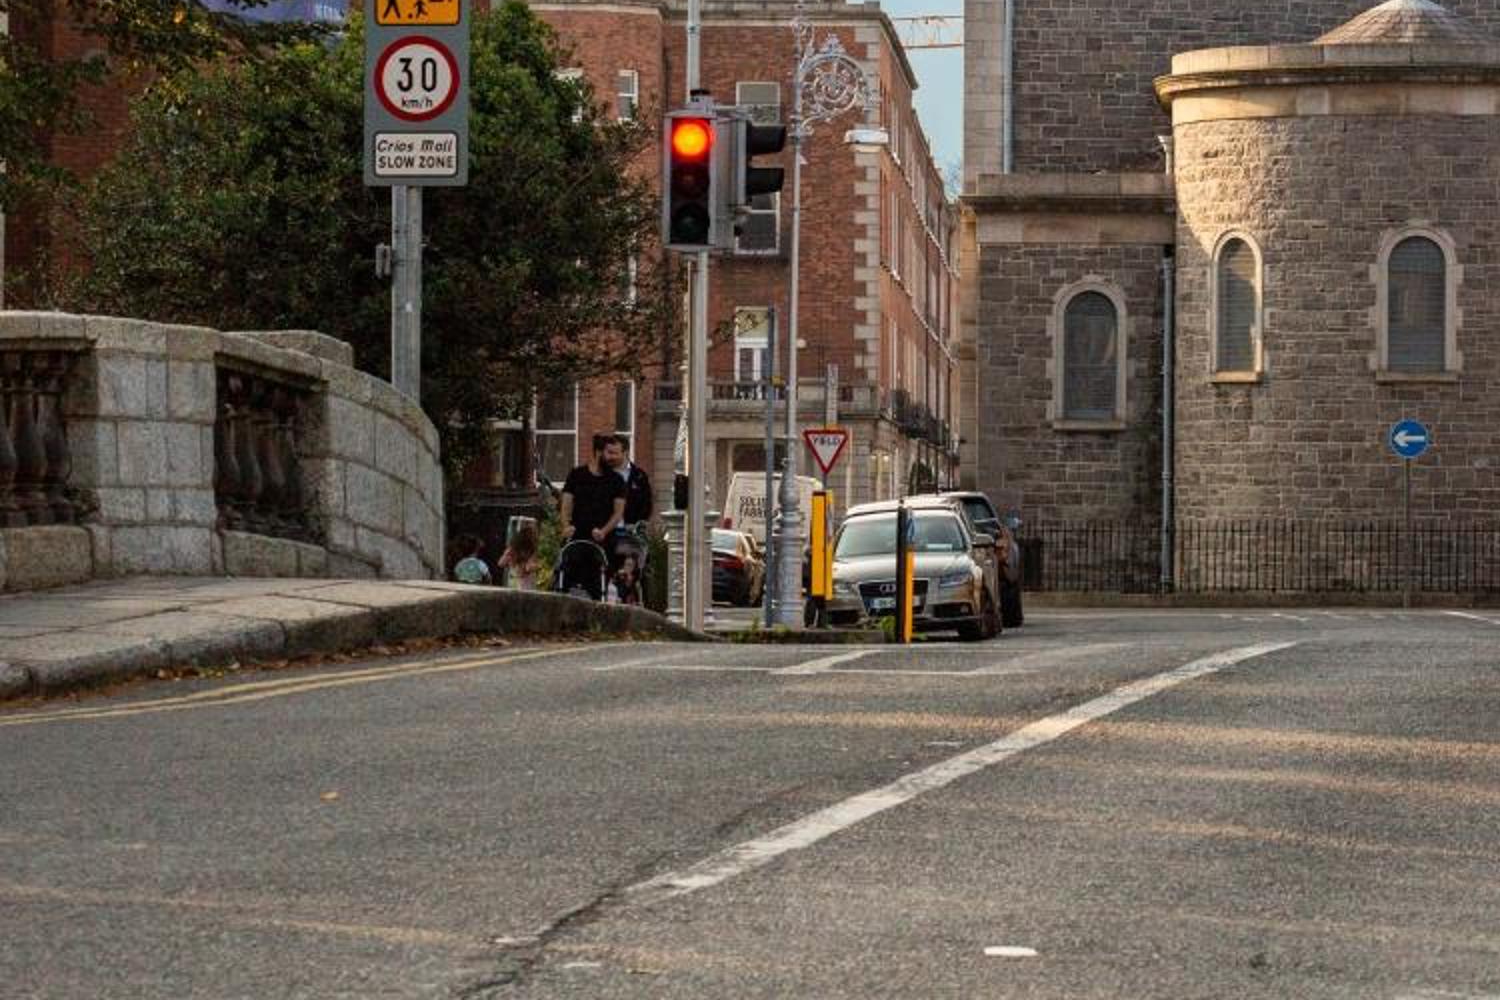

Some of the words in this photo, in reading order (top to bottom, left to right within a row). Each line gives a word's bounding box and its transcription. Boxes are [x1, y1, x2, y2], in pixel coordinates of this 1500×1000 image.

[397, 57, 437, 92] 30
[401, 97, 433, 108] km/h
[378, 155, 415, 169] SLOW
[418, 155, 454, 169] ZONE
